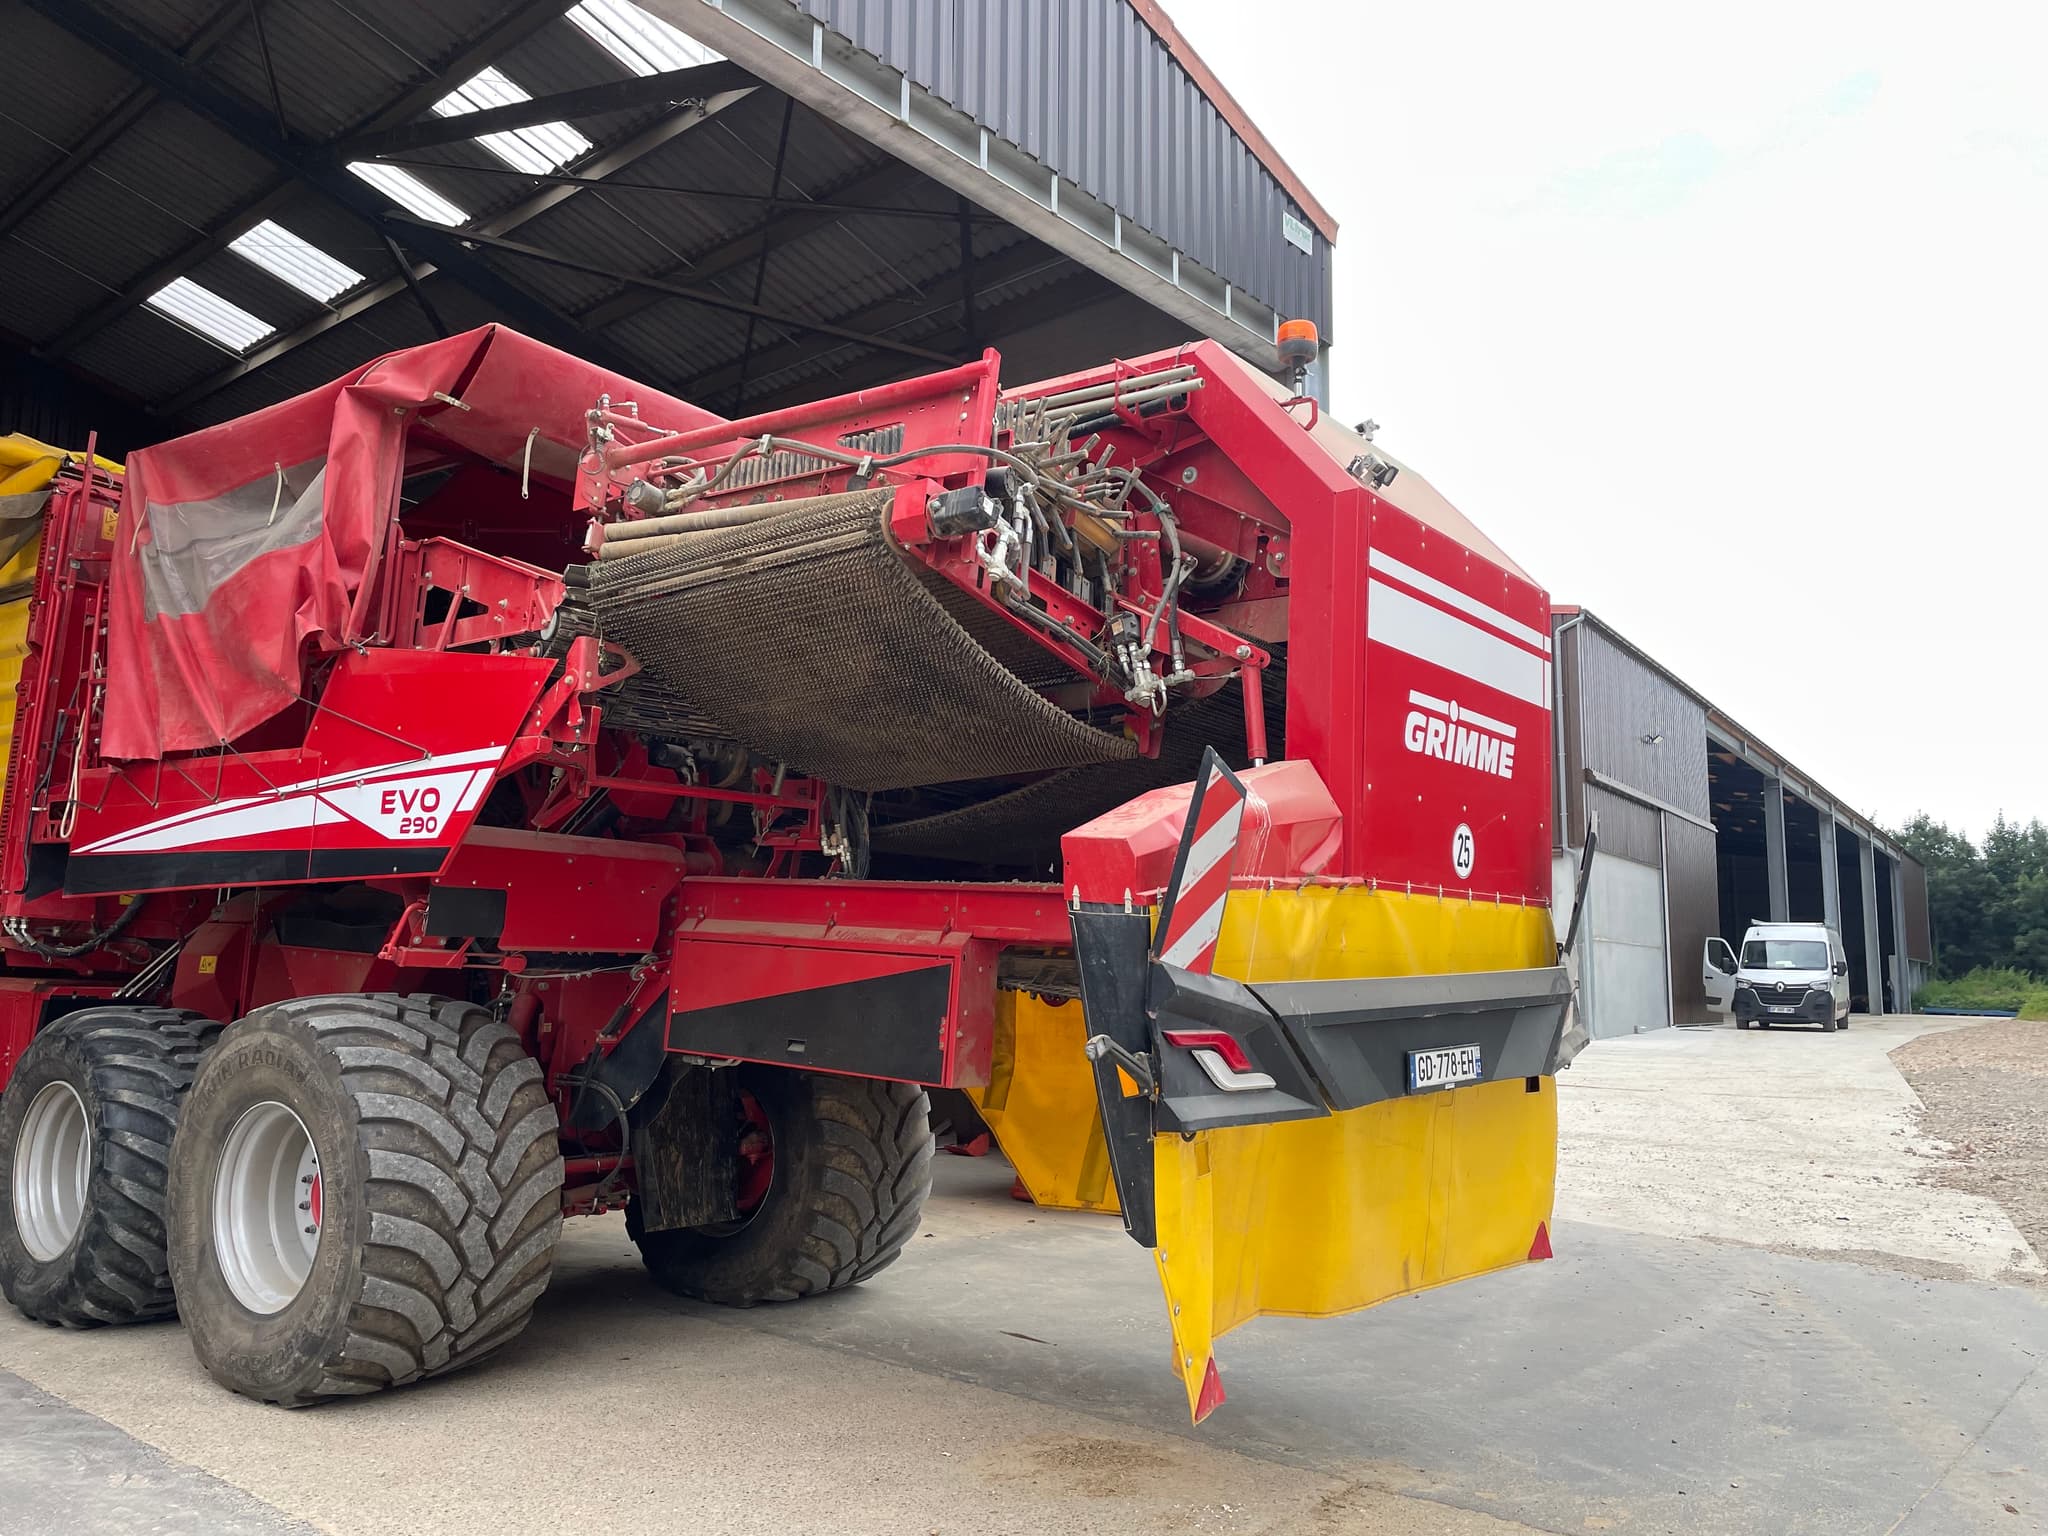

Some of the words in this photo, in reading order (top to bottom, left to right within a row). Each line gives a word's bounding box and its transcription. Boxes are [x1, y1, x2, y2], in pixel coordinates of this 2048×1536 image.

[1404, 700, 1515, 779] GRIMME
[381, 787, 440, 814] EVO
[400, 816, 437, 834] 290
[1456, 834, 1471, 868] 25
[1418, 1050, 1475, 1081] GD-778-EH
